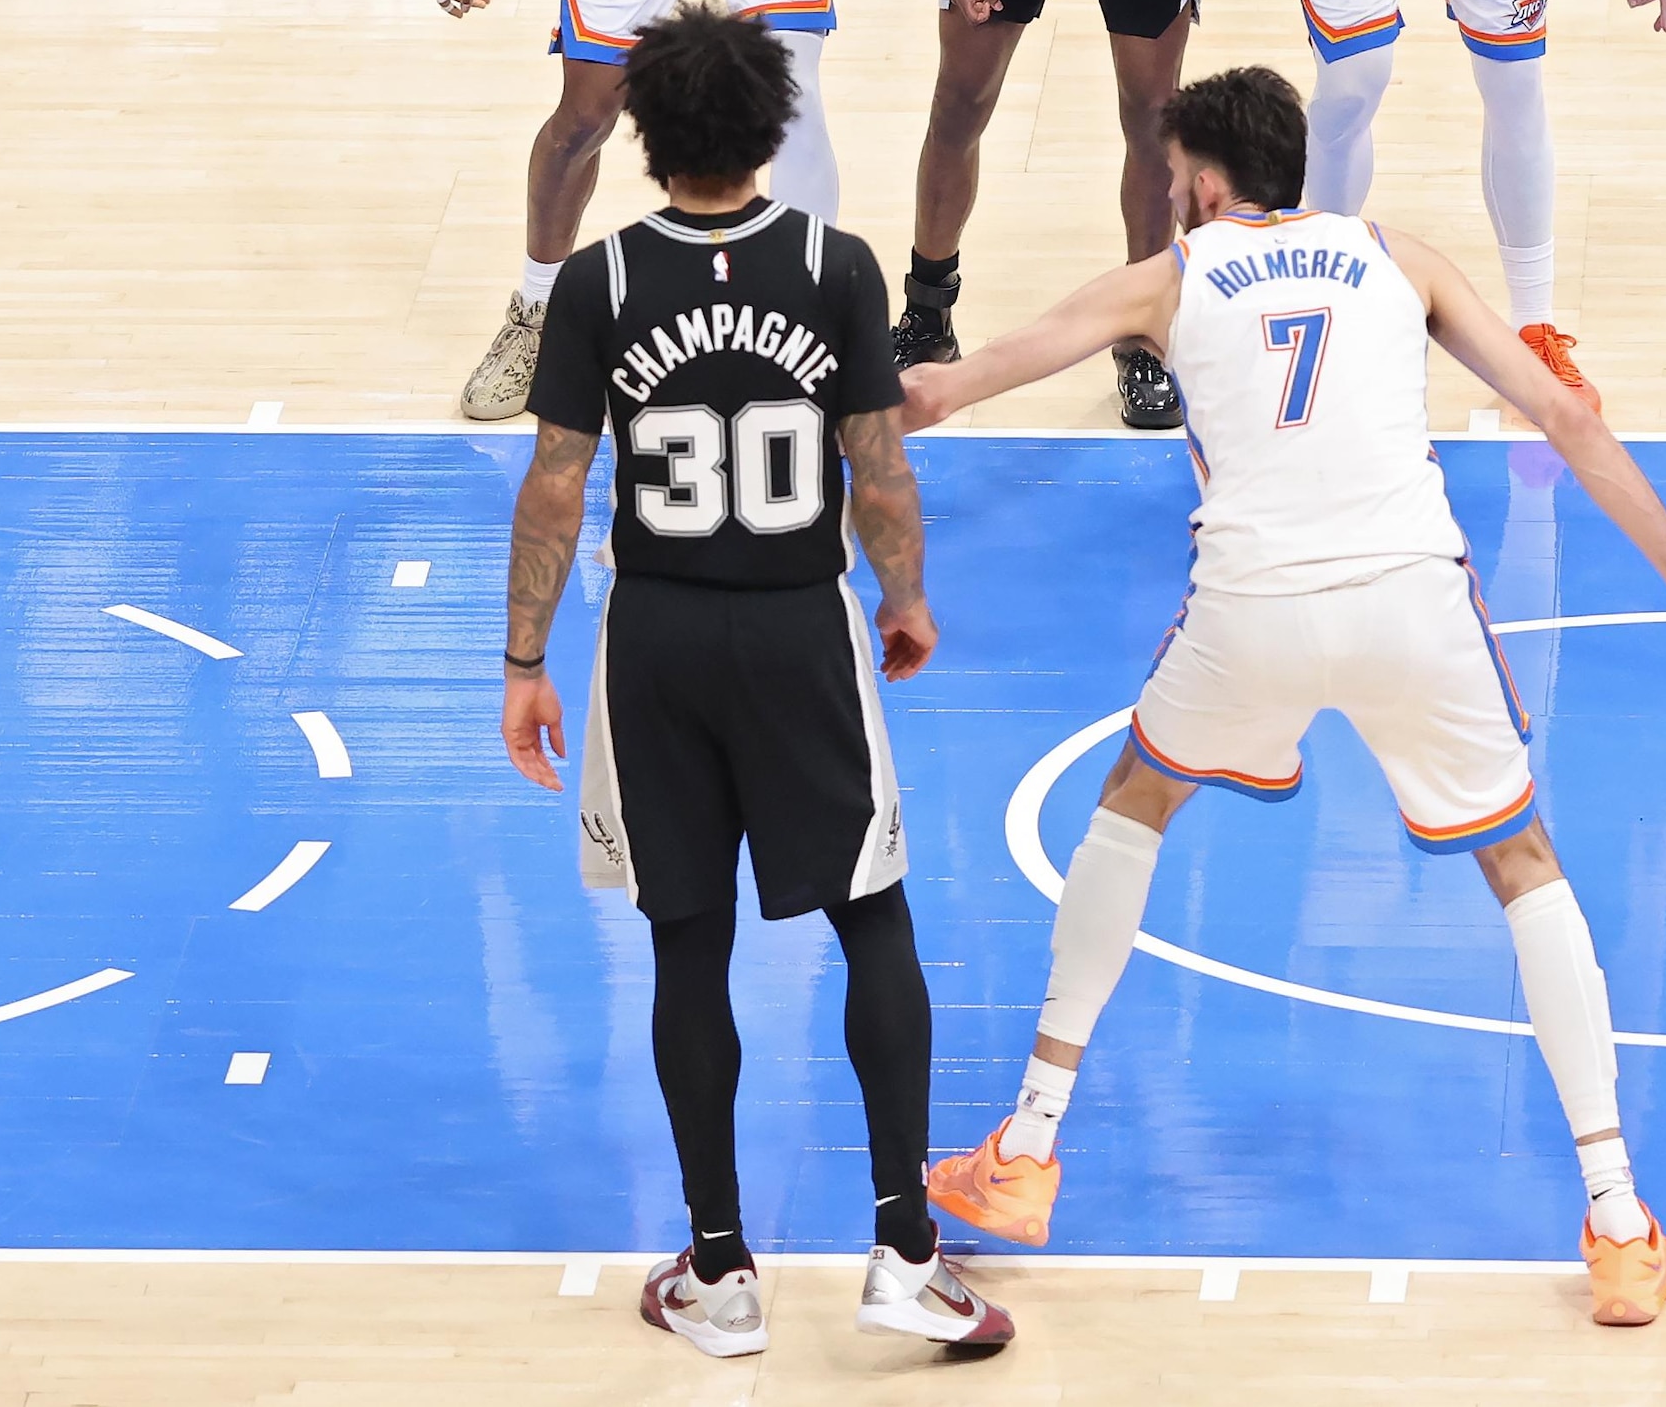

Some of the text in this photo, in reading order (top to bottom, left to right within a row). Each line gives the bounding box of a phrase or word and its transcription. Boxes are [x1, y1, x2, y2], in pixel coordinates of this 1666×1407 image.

[1205, 248, 1368, 300] HOLMGREN
[611, 303, 839, 403] CHAMPAGNIE
[1261, 306, 1332, 430] 7
[629, 397, 826, 538] 30
